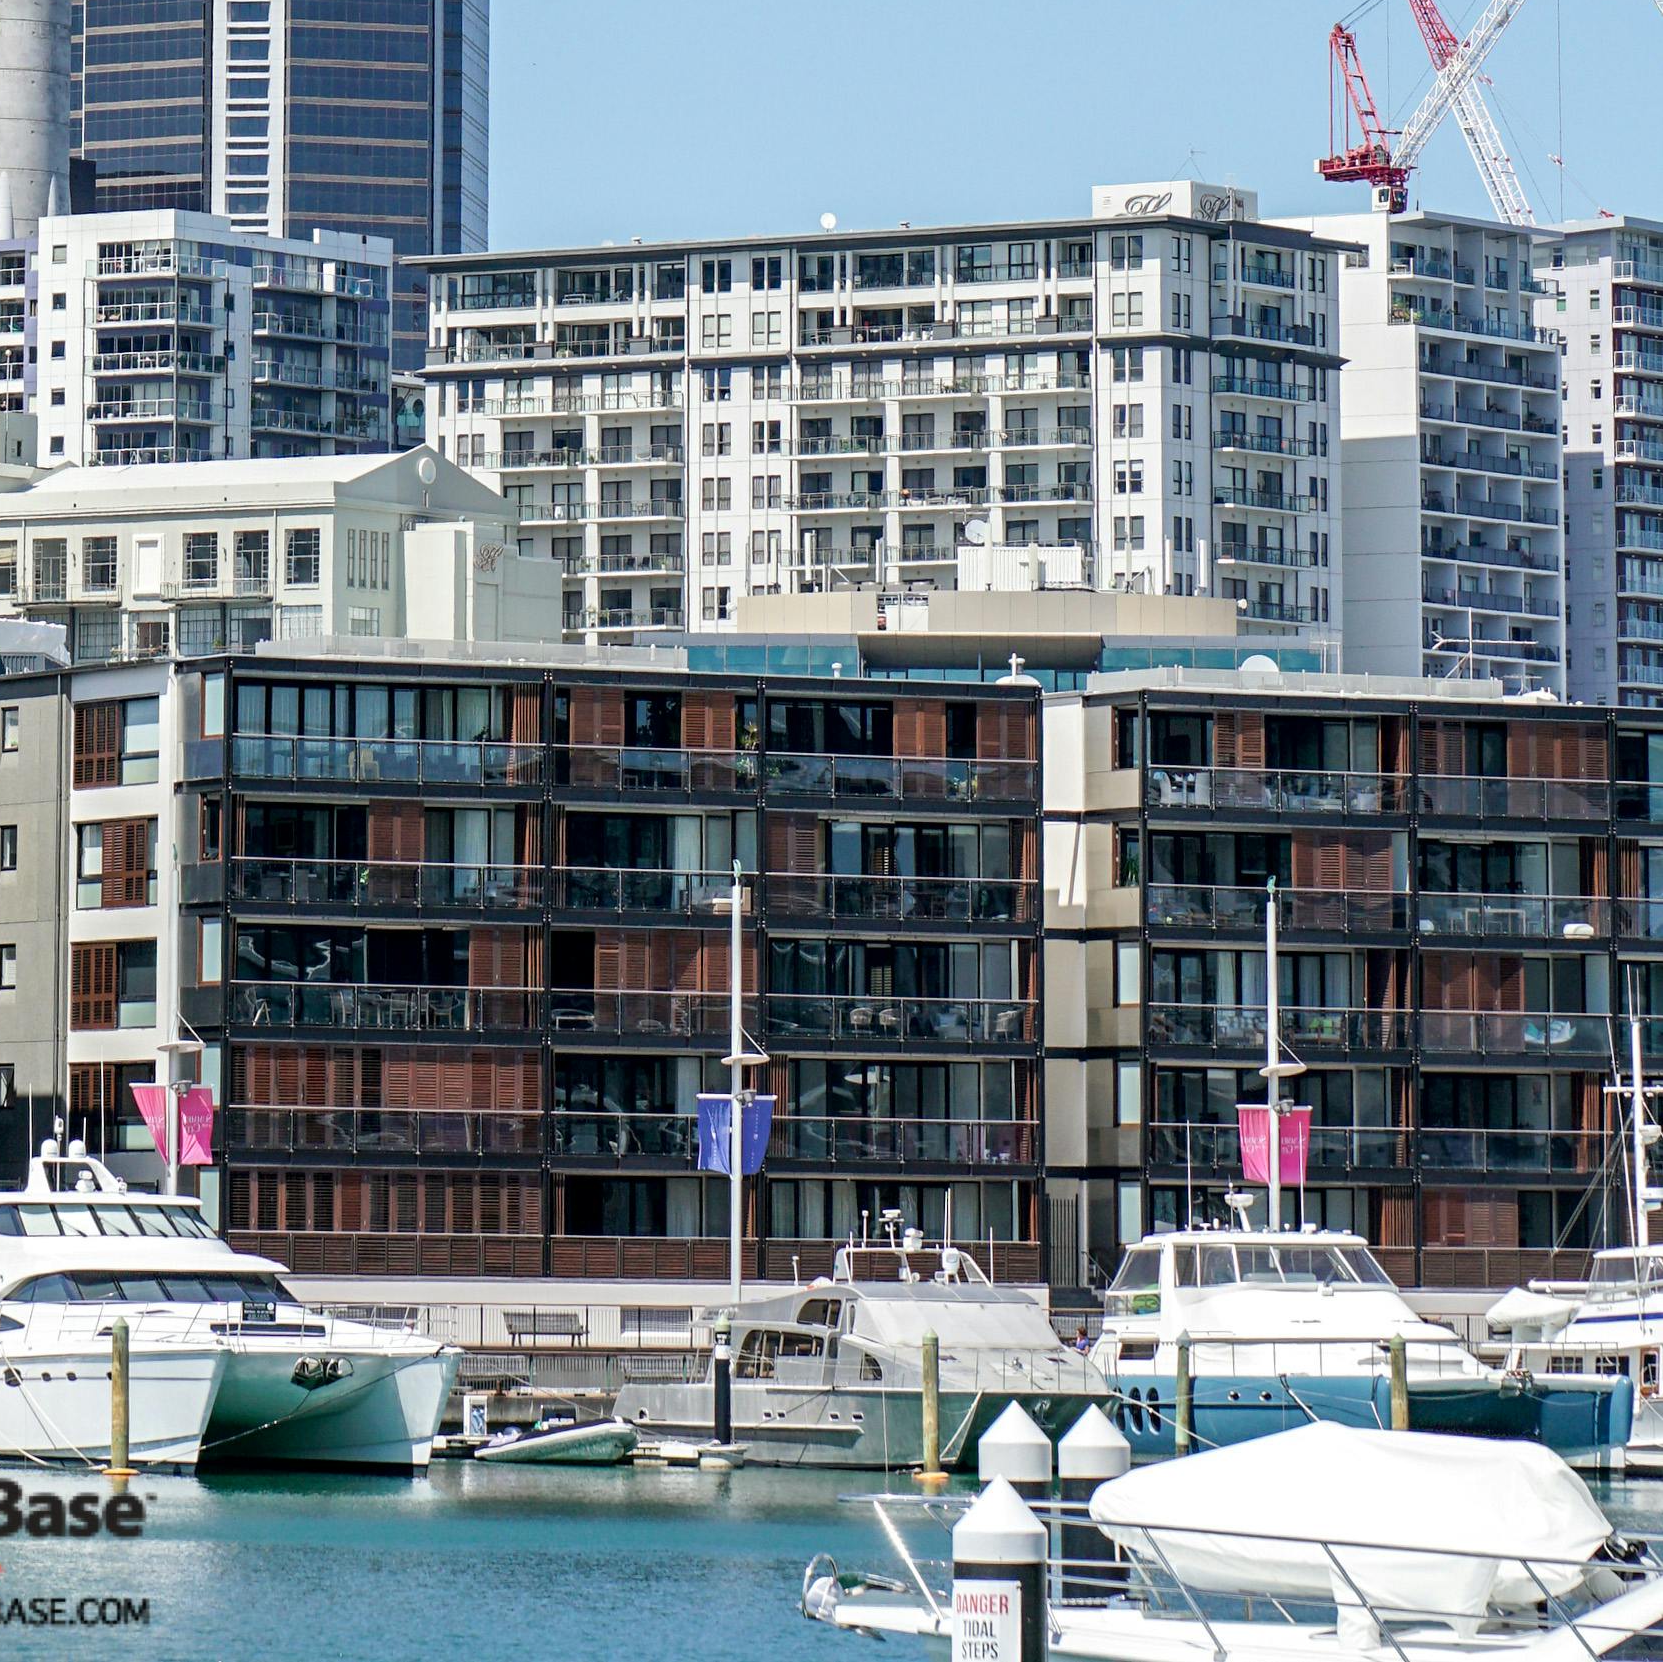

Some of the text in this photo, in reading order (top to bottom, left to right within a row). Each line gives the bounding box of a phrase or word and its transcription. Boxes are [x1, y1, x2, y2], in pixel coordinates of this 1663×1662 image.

[955, 1593, 1010, 1614] DANGER
[962, 1620, 997, 1638] TIDAL
[961, 1641, 999, 1659] STEPS
